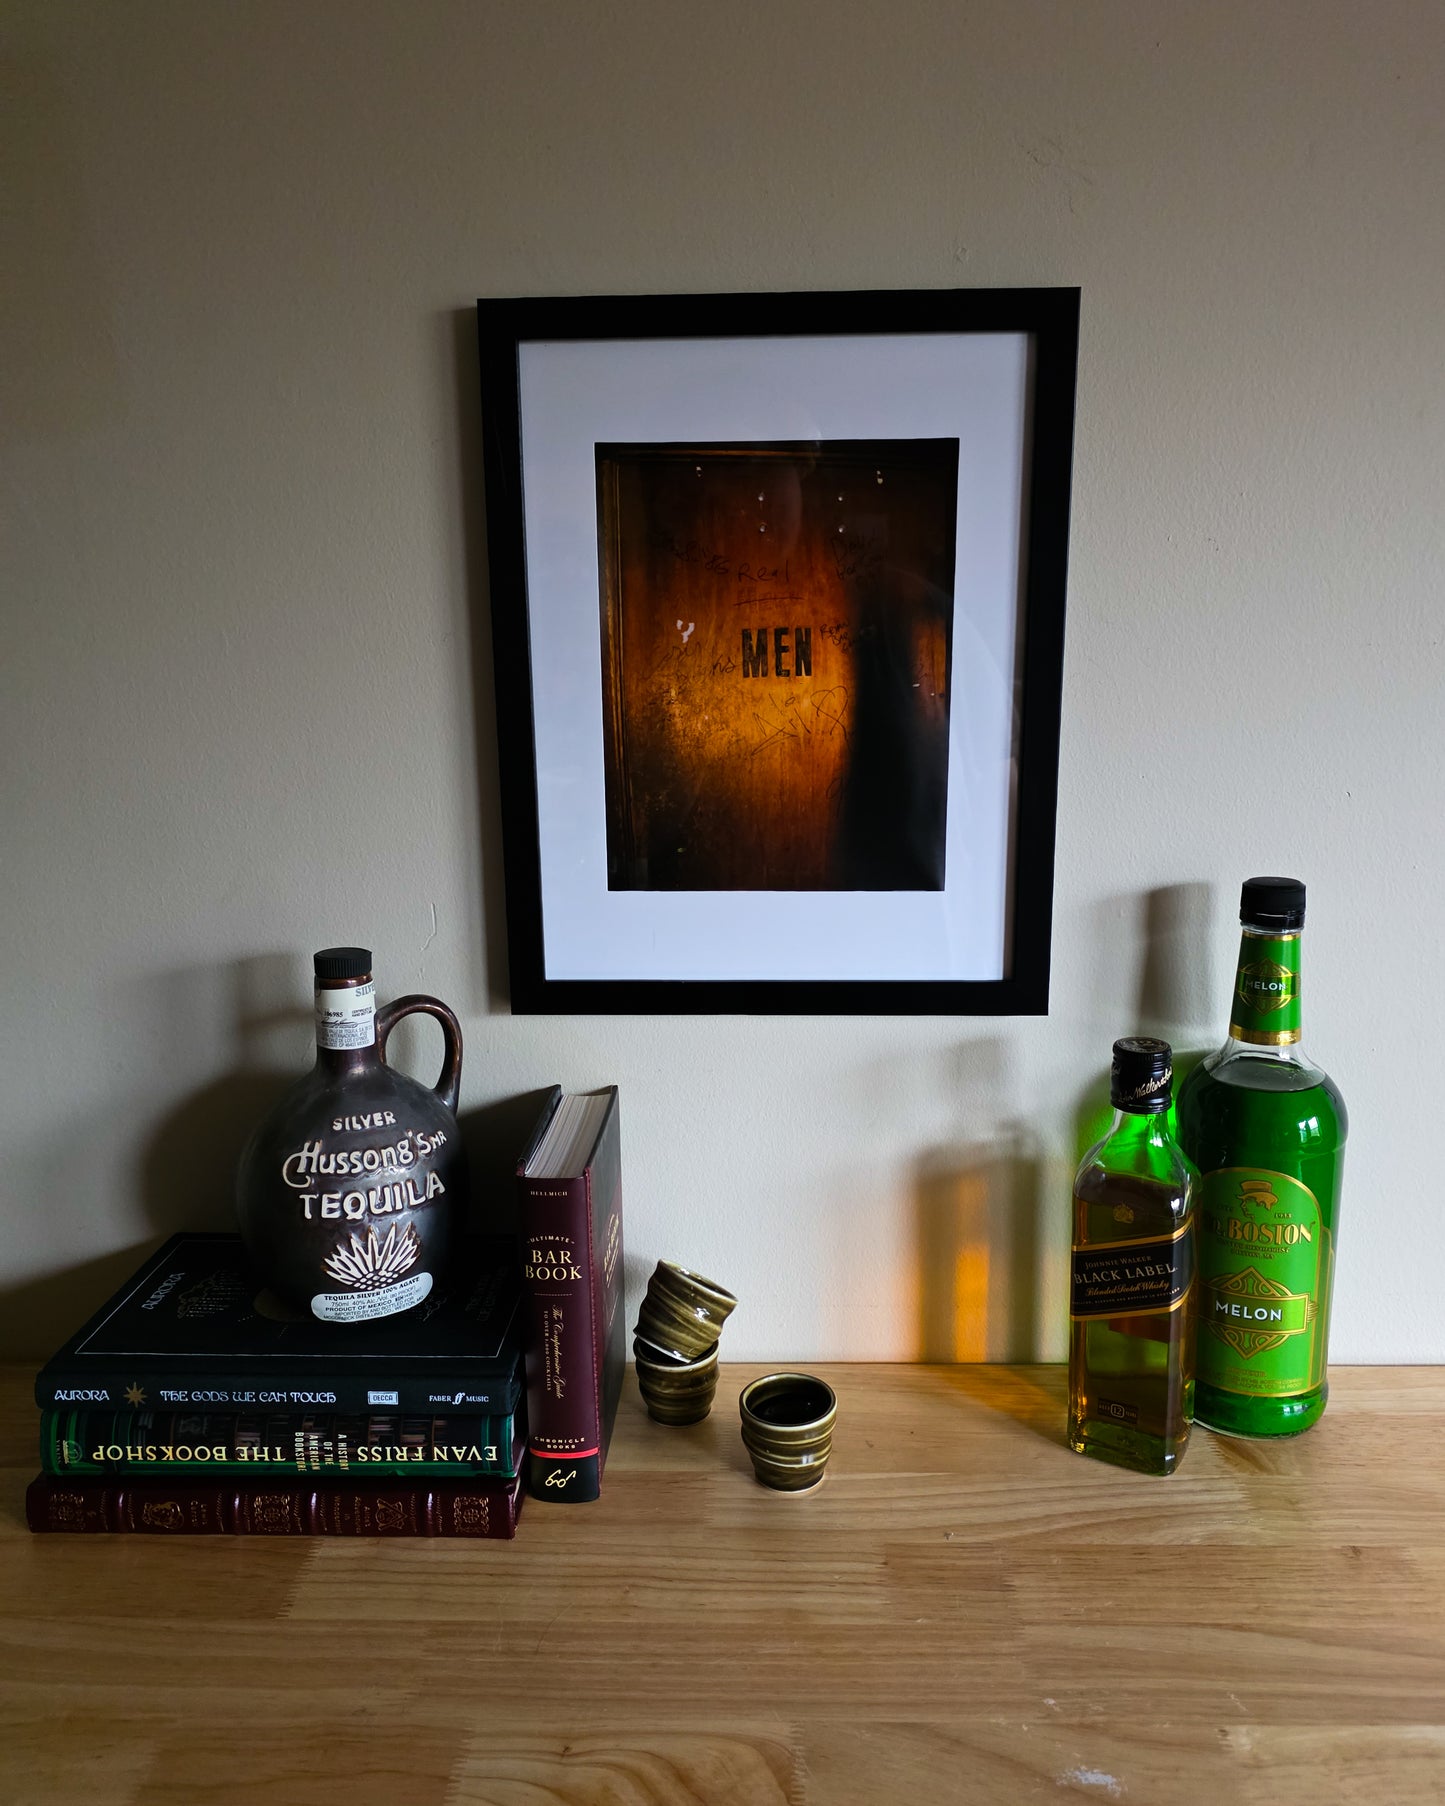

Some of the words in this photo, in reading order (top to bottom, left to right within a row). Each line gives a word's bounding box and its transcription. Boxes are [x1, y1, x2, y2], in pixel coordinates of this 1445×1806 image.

[742, 627, 812, 678] MEN
[1245, 980, 1286, 991] MELON
[332, 1110, 397, 1131] SILVER
[429, 1130, 448, 1149] MR
[299, 1171, 446, 1220] TEQUILA
[530, 1235, 570, 1244] ULTIMATE
[1228, 1218, 1314, 1246] BOSTON
[532, 1249, 573, 1264] BAR
[1120, 1255, 1153, 1264] WALKER
[525, 1265, 583, 1281] BOOK
[1073, 1269, 1122, 1284] BLACK
[1125, 1263, 1176, 1279] LABEL
[141, 1272, 186, 1310] AURORA
[356, 1290, 381, 1299] SILVER
[382, 1286, 398, 1295] 100%
[1086, 1285, 1117, 1297] Blended
[1117, 1283, 1140, 1293] Scotch
[1140, 1279, 1170, 1290] Whisky
[368, 1299, 392, 1309] MEXICO
[1215, 1300, 1282, 1321] MELON
[54, 1389, 110, 1401] AURORA
[159, 1390, 188, 1402] THE
[191, 1391, 229, 1402] GODS
[232, 1391, 256, 1402] WE
[259, 1391, 287, 1403] CAN
[289, 1391, 337, 1403] TOUCH
[429, 1394, 452, 1402] FABER
[465, 1395, 490, 1403] MUSIC
[323, 1441, 333, 1452] OF
[534, 1436, 585, 1444] CHRONICLE
[92, 1445, 227, 1462] BOOKSHOP
[237, 1446, 287, 1462] THE
[294, 1431, 307, 1472] BOOKSTORE
[308, 1434, 321, 1471] AMERICAN
[324, 1453, 335, 1466] THE
[337, 1442, 350, 1472] HISTORY
[357, 1446, 424, 1462] FRISS
[433, 1445, 498, 1462] EVAN
